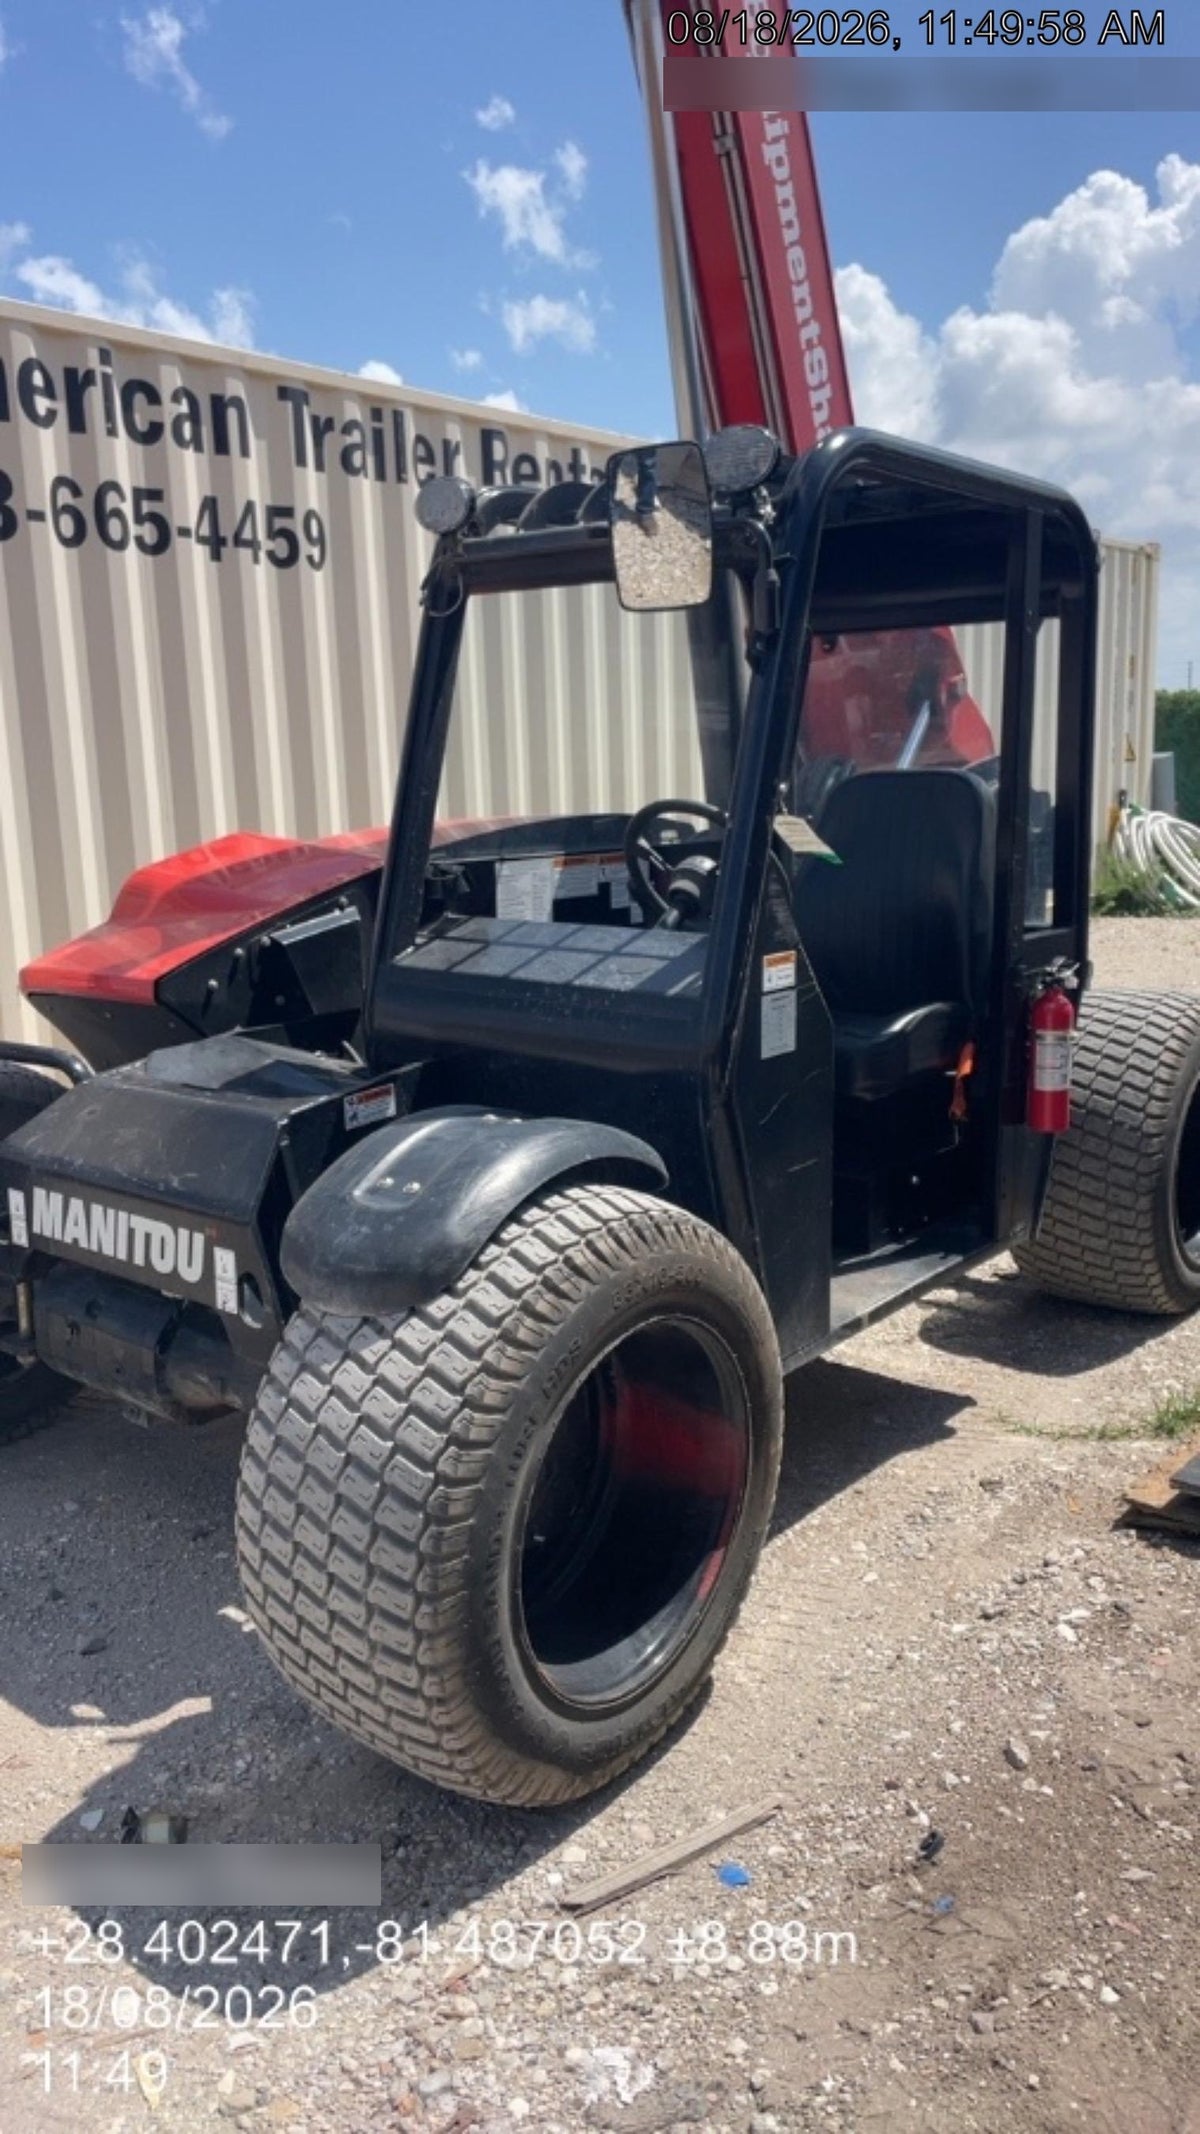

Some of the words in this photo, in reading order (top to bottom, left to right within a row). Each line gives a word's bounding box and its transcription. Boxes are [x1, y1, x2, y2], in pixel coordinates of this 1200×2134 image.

[0, 347, 251, 459] erican
[277, 385, 461, 486] Trailer
[33, 1186, 205, 1283] MANITOU
